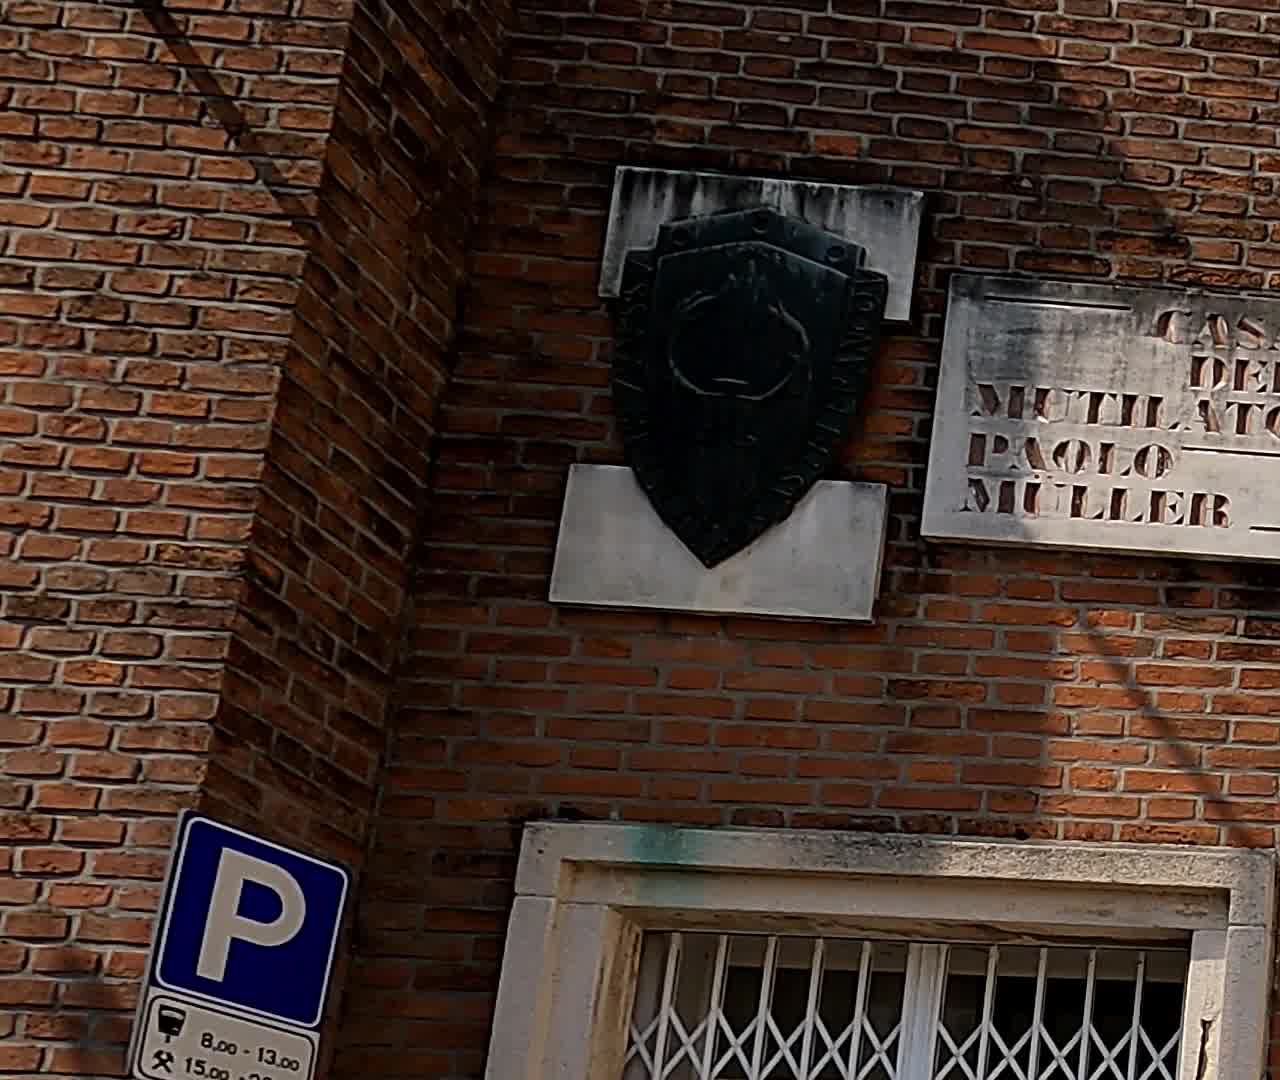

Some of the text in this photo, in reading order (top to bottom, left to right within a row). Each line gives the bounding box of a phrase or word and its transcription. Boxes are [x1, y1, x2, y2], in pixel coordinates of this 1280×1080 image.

[966, 432, 1174, 480] PAOLO
[196, 847, 306, 983] P
[201, 1032, 238, 1055] 8.00
[258, 1047, 300, 1071] 13.00
